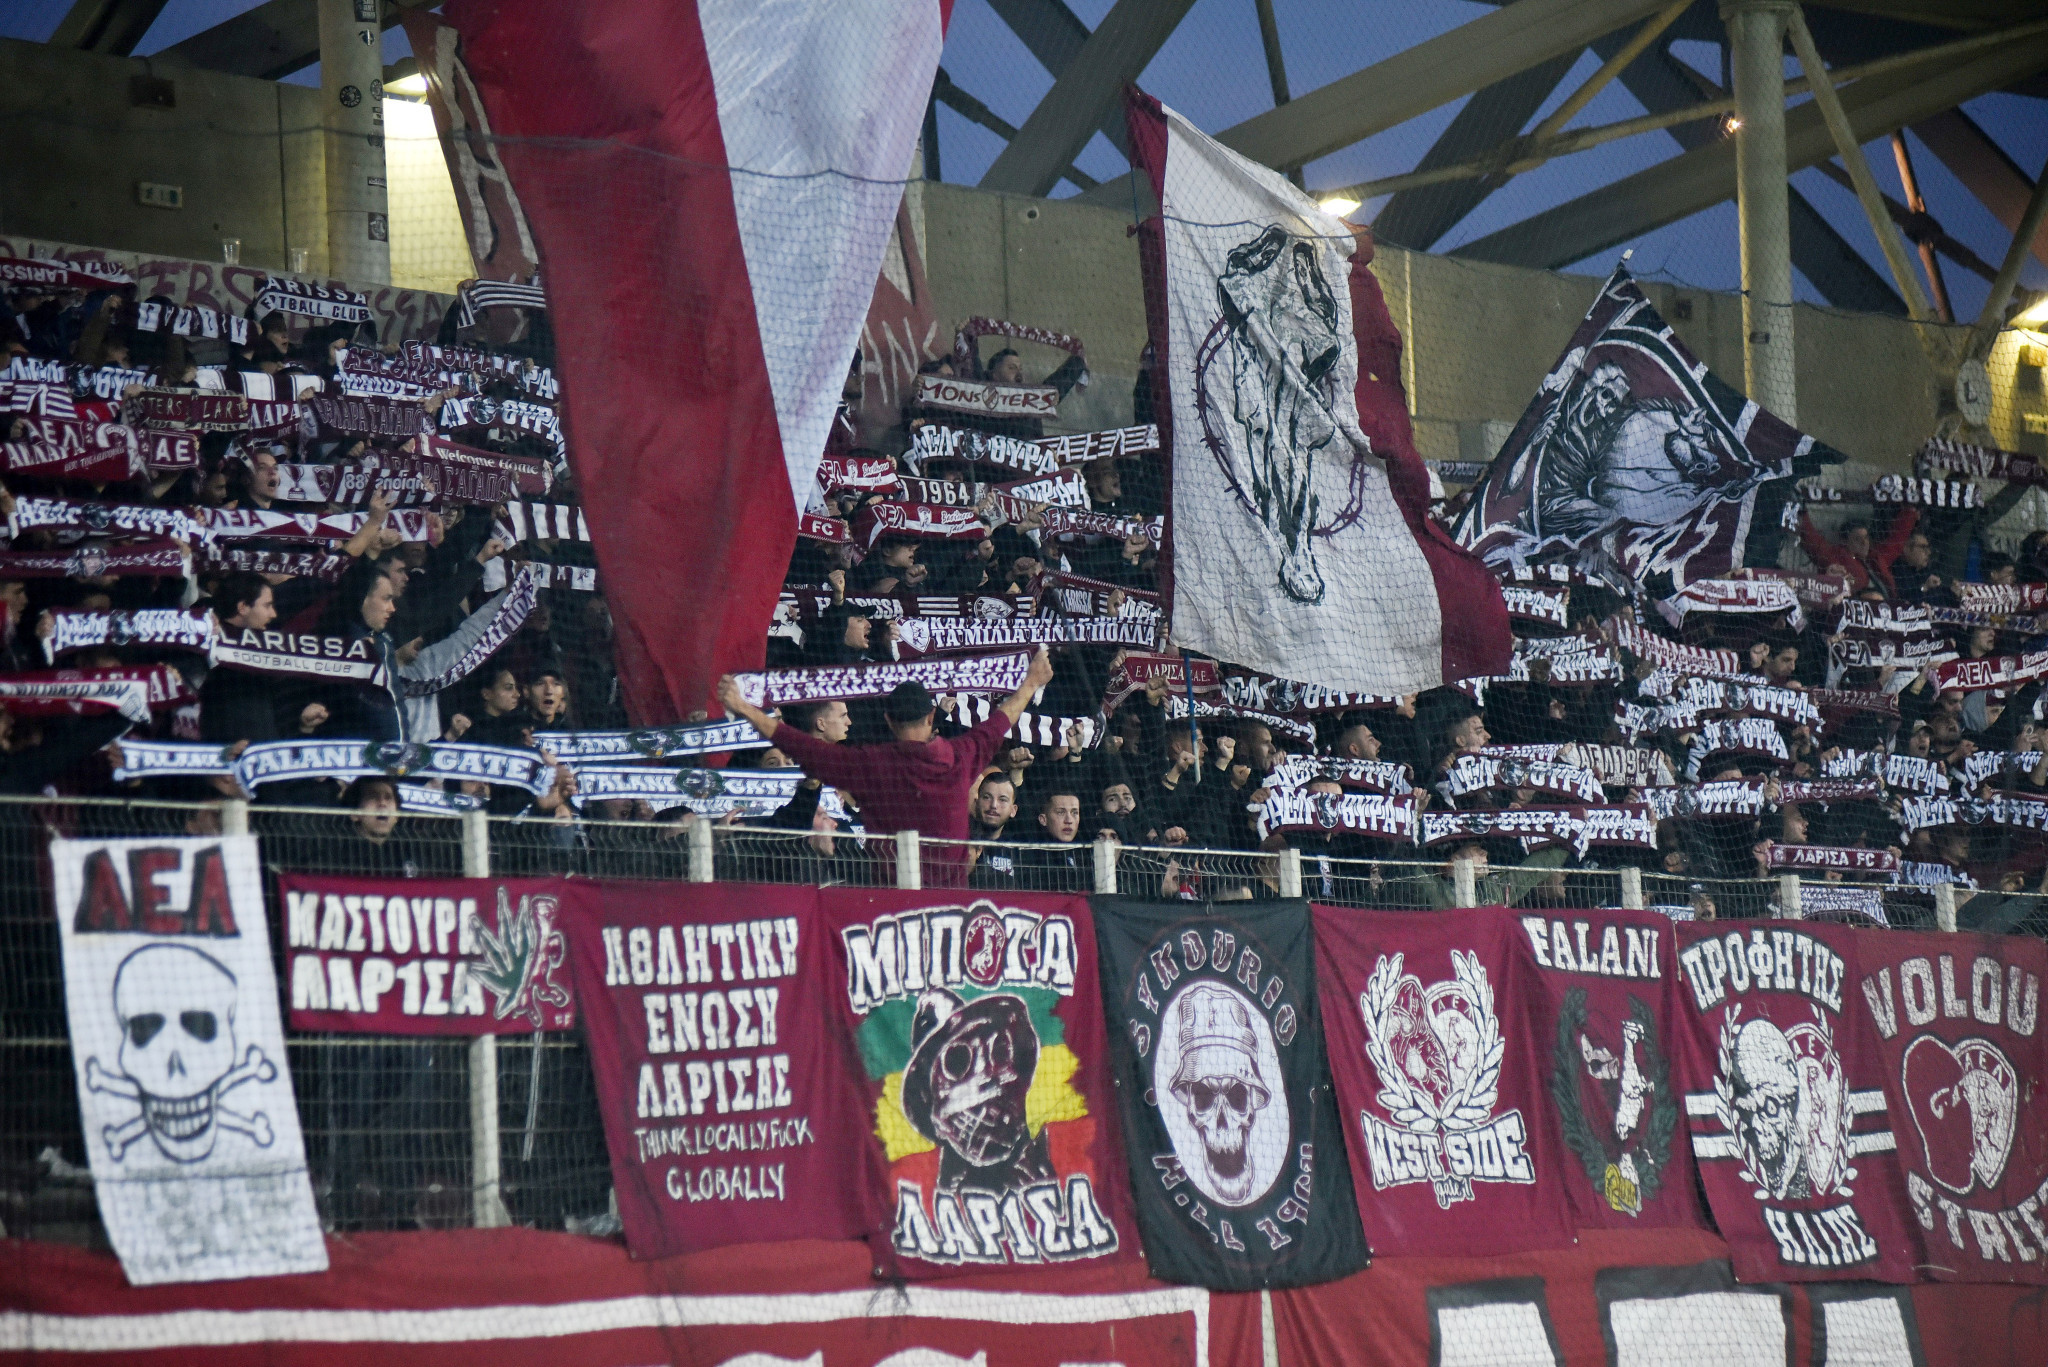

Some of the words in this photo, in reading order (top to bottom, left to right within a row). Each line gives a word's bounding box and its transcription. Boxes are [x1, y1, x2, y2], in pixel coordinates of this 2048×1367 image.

[0, 264, 67, 285] LARISS
[265, 277, 367, 304] ARISSA
[261, 294, 323, 316] FTBALL
[332, 304, 371, 321] CLUB
[436, 446, 495, 469] Welcome
[918, 481, 971, 506] 1964
[811, 521, 834, 537] FC
[218, 626, 367, 660] LARISSA
[232, 650, 310, 671] FOOTBALL
[314, 662, 353, 675] CLUB
[1144, 663, 1185, 681] ΛΑΡΙΣΑ
[1956, 660, 1996, 688] ΑΕΛ
[541, 735, 629, 755] ALANI
[682, 724, 760, 748] GATE
[431, 749, 532, 783] GATE
[576, 774, 677, 796] FALANI
[1340, 793, 1399, 835] ΘΥΡΑ
[1792, 847, 1849, 866] ΛΑΡΙΣΑ
[1856, 852, 1875, 868] FC
[74, 845, 240, 938] ΑΕΛ
[602, 916, 799, 987] ΑΘΛΗΤΙΚΗ
[1522, 916, 1661, 979] FALANI
[1680, 929, 1845, 1014] ΠΡΟΦΗΤΗΣ
[1861, 955, 2039, 1041] VOLOU
[643, 986, 779, 1055] ΕΝΩΣΗ
[636, 1053, 793, 1119] ΛΑΡΙΣΑΣ
[1361, 1109, 1445, 1191] WEST
[1444, 1108, 1537, 1184] SIDE
[666, 1162, 785, 1204] GLOBALLY
